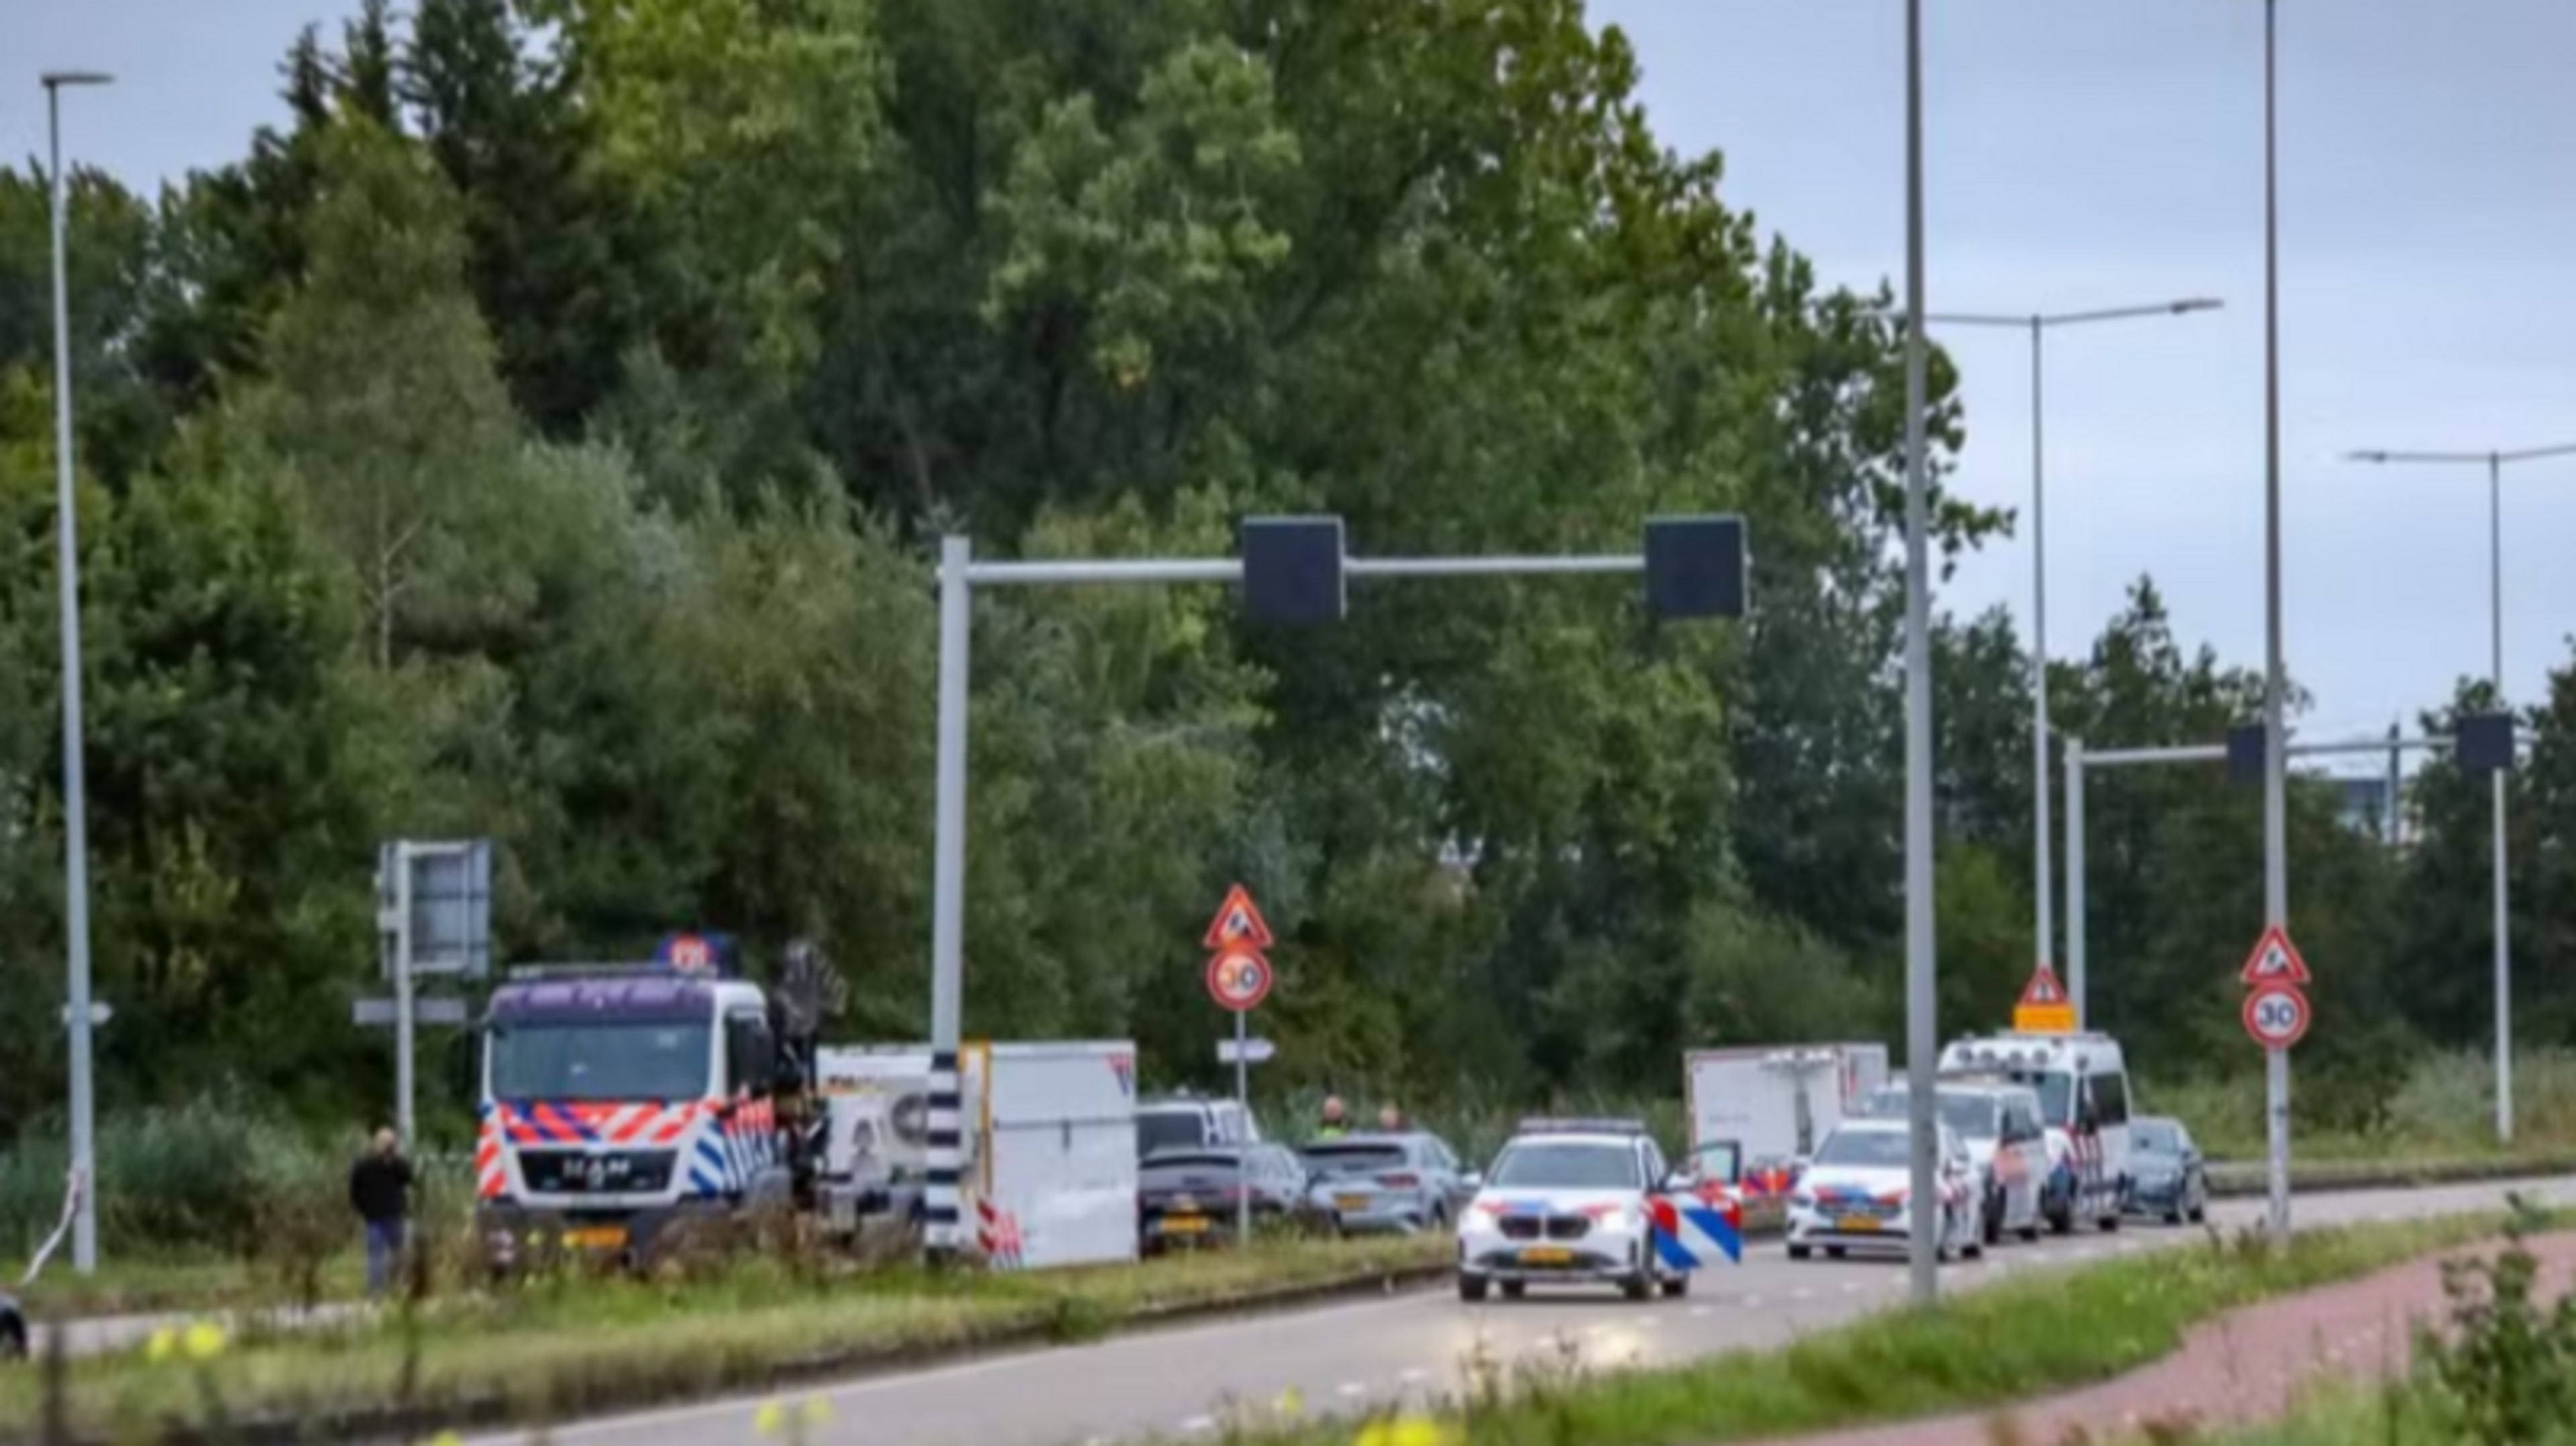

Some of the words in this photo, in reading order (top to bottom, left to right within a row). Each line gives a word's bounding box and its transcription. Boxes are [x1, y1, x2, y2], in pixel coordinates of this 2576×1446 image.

[1222, 963, 1258, 990] 30
[2258, 1002, 2296, 1027] 30
[562, 1157, 631, 1178] MAN
